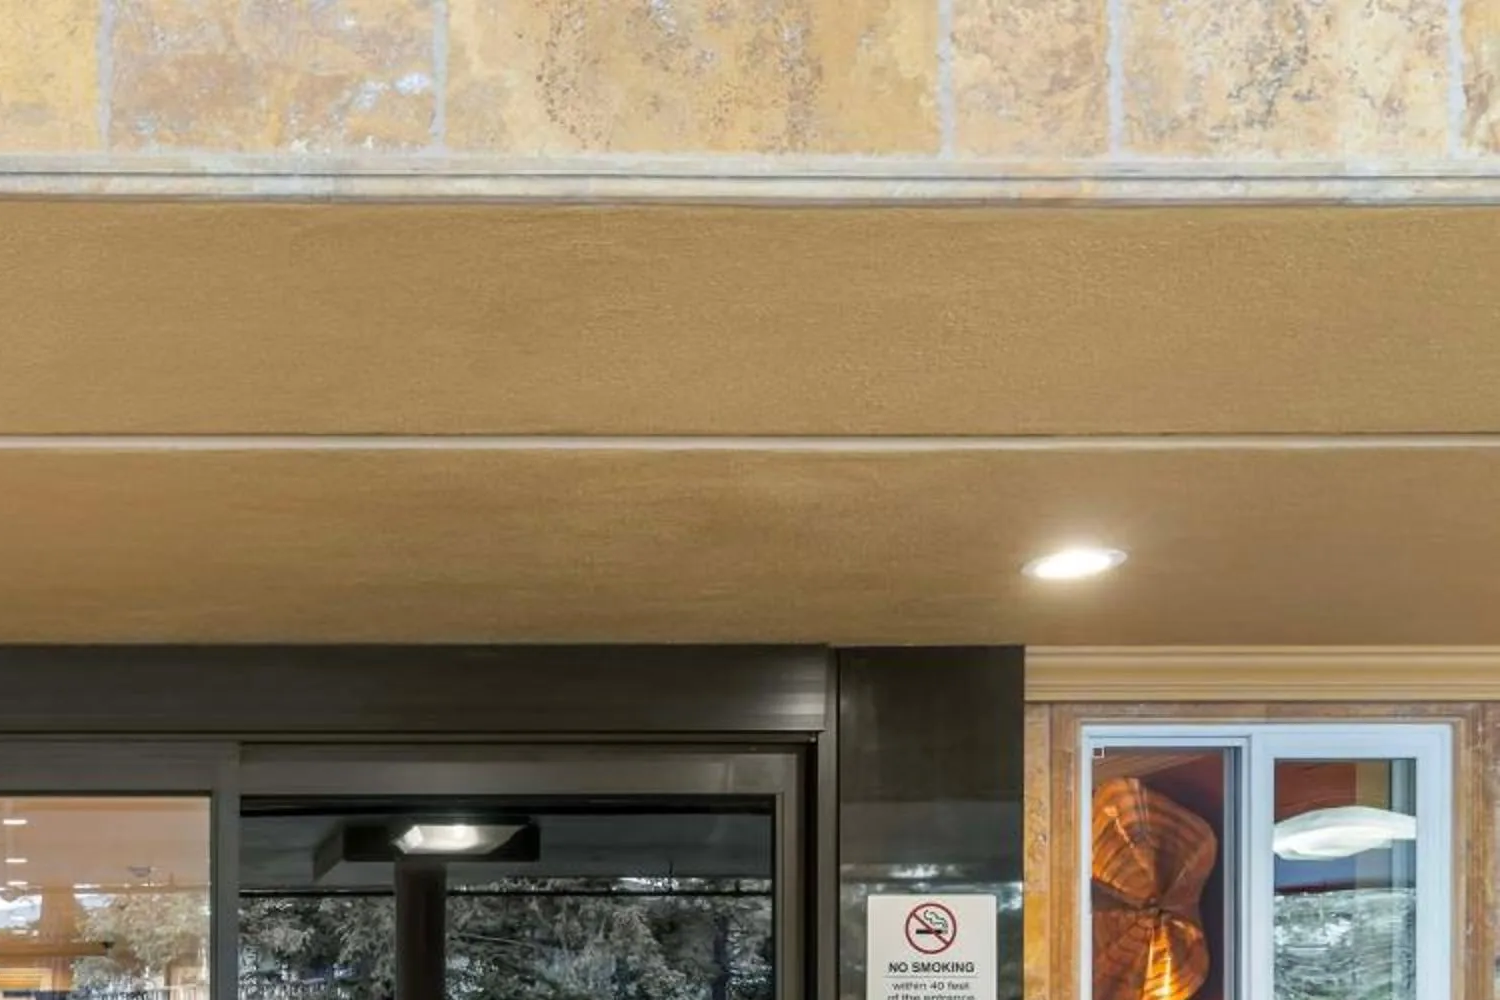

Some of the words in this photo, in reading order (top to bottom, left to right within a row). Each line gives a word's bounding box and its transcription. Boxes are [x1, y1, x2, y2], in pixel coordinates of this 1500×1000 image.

[888, 961, 908, 973] NO
[911, 961, 975, 973] SMOKING
[891, 981, 927, 990] within
[930, 981, 944, 990] 40
[947, 981, 969, 990] feet
